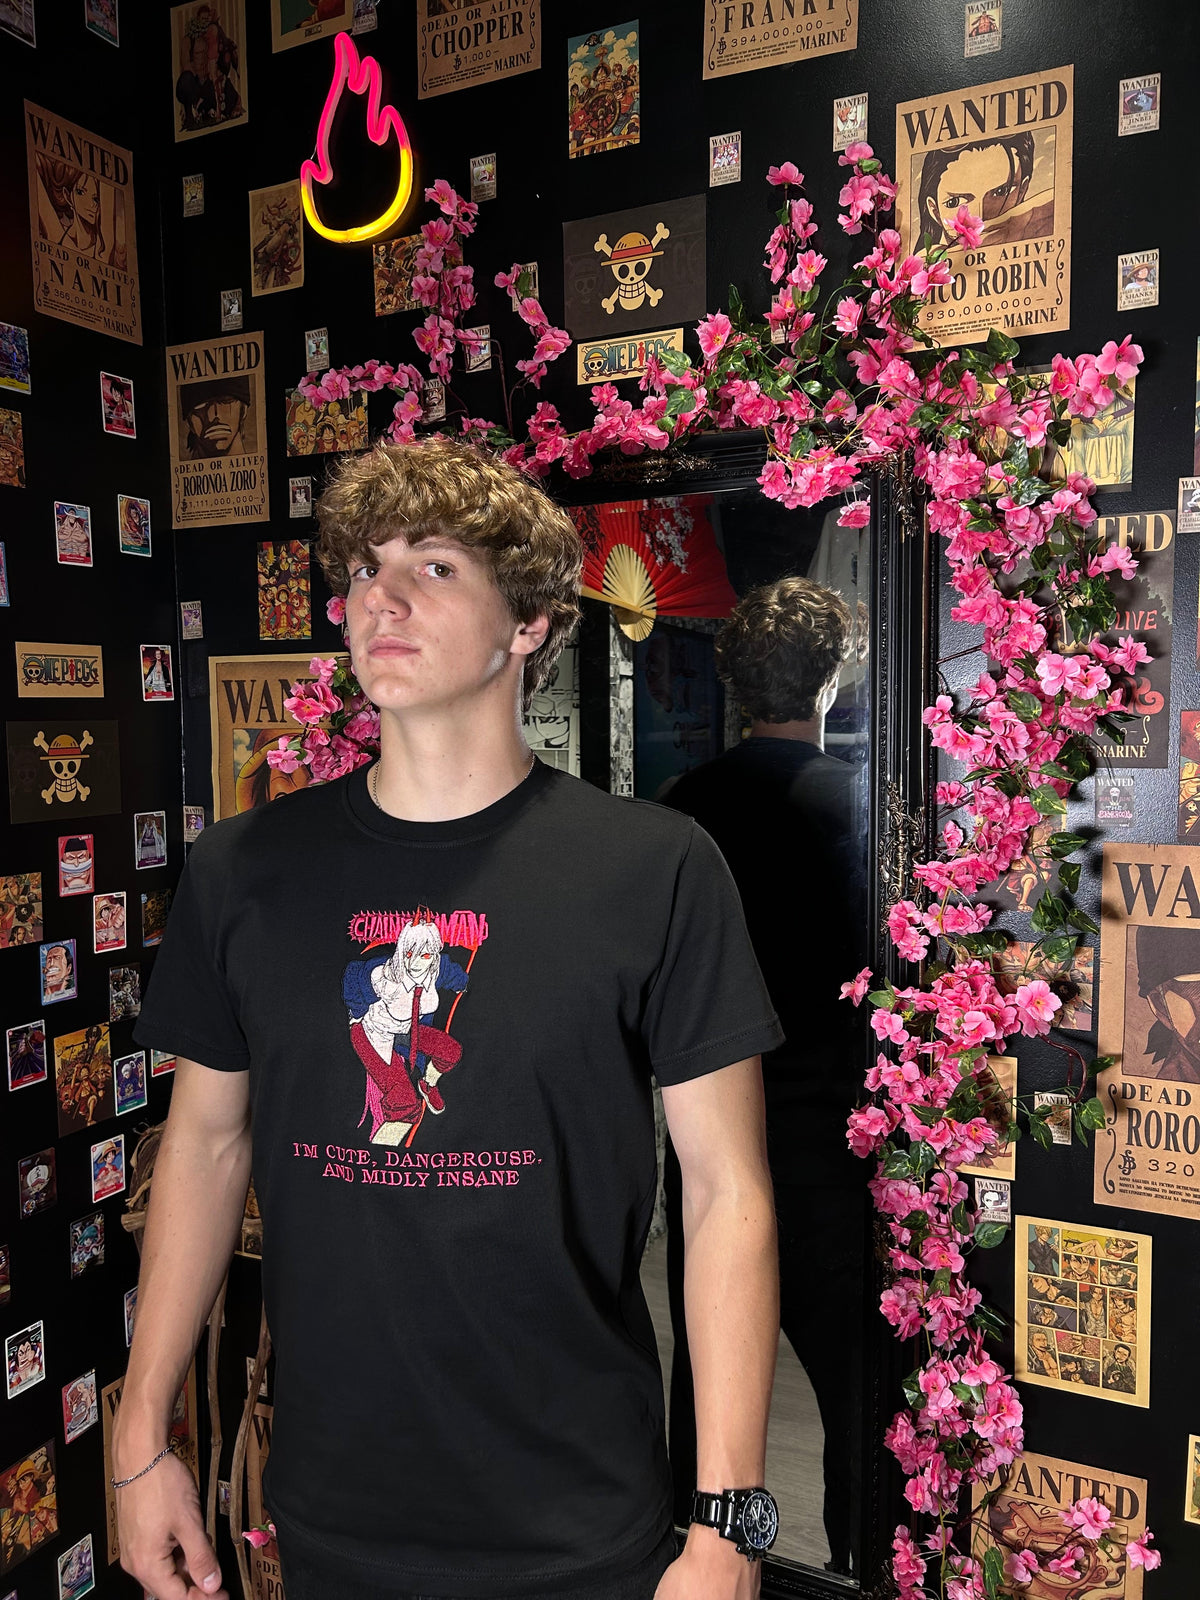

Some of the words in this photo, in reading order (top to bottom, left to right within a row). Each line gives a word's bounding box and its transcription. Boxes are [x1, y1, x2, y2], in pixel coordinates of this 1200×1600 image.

[967, 0, 1002, 14] WANTED
[427, 14, 458, 33] DEAD
[466, 8, 481, 21] OR
[431, 11, 524, 59] CHOPPER
[800, 27, 847, 51] MARINE
[494, 50, 533, 73] MARINE
[1122, 76, 1159, 92] WANTED
[835, 96, 867, 109] WANTED
[901, 80, 1069, 149] WANTED
[27, 111, 129, 186] WANTED
[711, 133, 741, 147] WANTED
[471, 155, 496, 168] WANTED
[39, 240, 69, 262] DEAD
[76, 255, 91, 270] OR
[98, 265, 129, 285] ALIVE
[964, 252, 987, 267] OR
[1000, 239, 1055, 262] ALIVE
[1121, 252, 1158, 267] WANTED
[50, 259, 123, 307] NAMI
[926, 272, 967, 306] ICO
[976, 258, 1049, 299] ROBIN
[103, 316, 135, 338] MARINE
[1003, 306, 1059, 330] MARINE
[169, 341, 261, 381] WANTED
[179, 462, 204, 474] DEAD
[210, 459, 222, 470] OR
[229, 455, 260, 468] ALIVE
[183, 472, 228, 497] RORONOA
[230, 469, 257, 493] ZORO
[233, 504, 264, 518] MARINE
[1109, 609, 1158, 630] LIVE
[1096, 744, 1147, 758] MARINE
[1097, 778, 1134, 787] WANTED
[1120, 1081, 1193, 1108] DEAD
[292, 1142, 319, 1159] I'M
[325, 1145, 378, 1167] CUTE,
[322, 1162, 355, 1183] AND
[361, 1168, 431, 1188] MIDLY
[437, 1170, 521, 1188] INSANE
[977, 1181, 1010, 1192] WANTED
